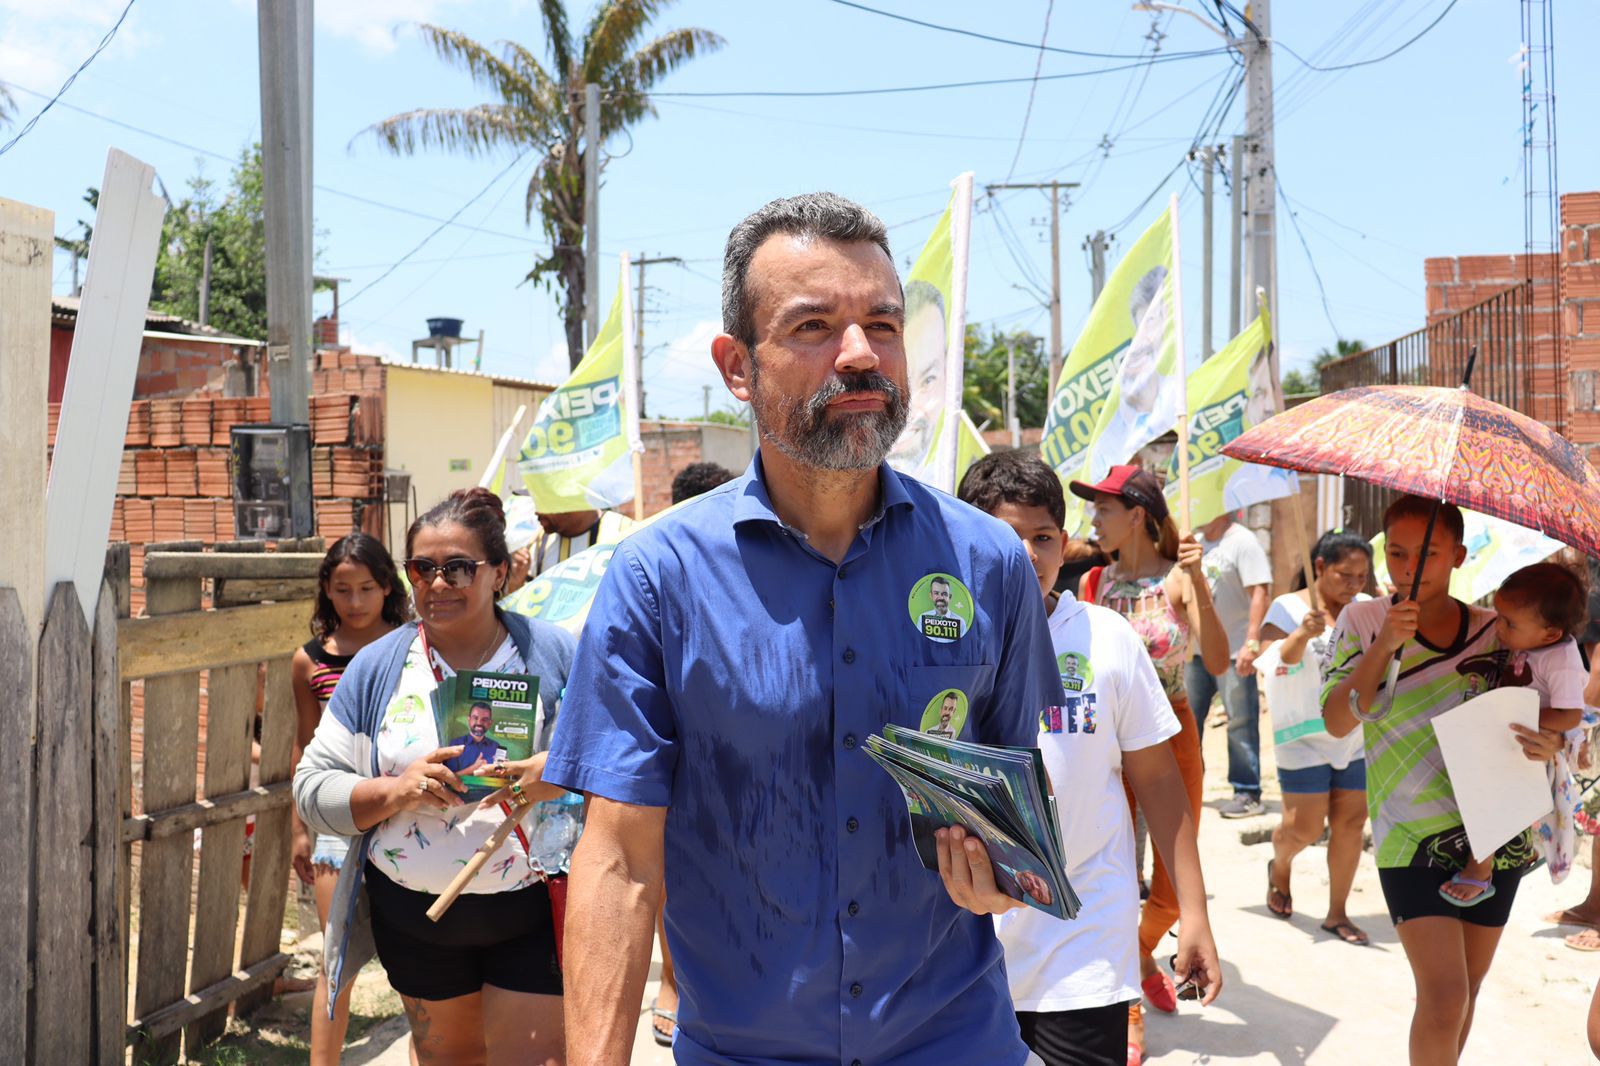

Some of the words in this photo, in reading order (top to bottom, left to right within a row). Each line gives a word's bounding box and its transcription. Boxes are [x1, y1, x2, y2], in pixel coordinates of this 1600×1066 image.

[924, 618, 958, 627] PEIXOTO
[925, 625, 958, 638] 90.111
[472, 677, 528, 691] PEIXOTO
[488, 688, 527, 702] 90.111
